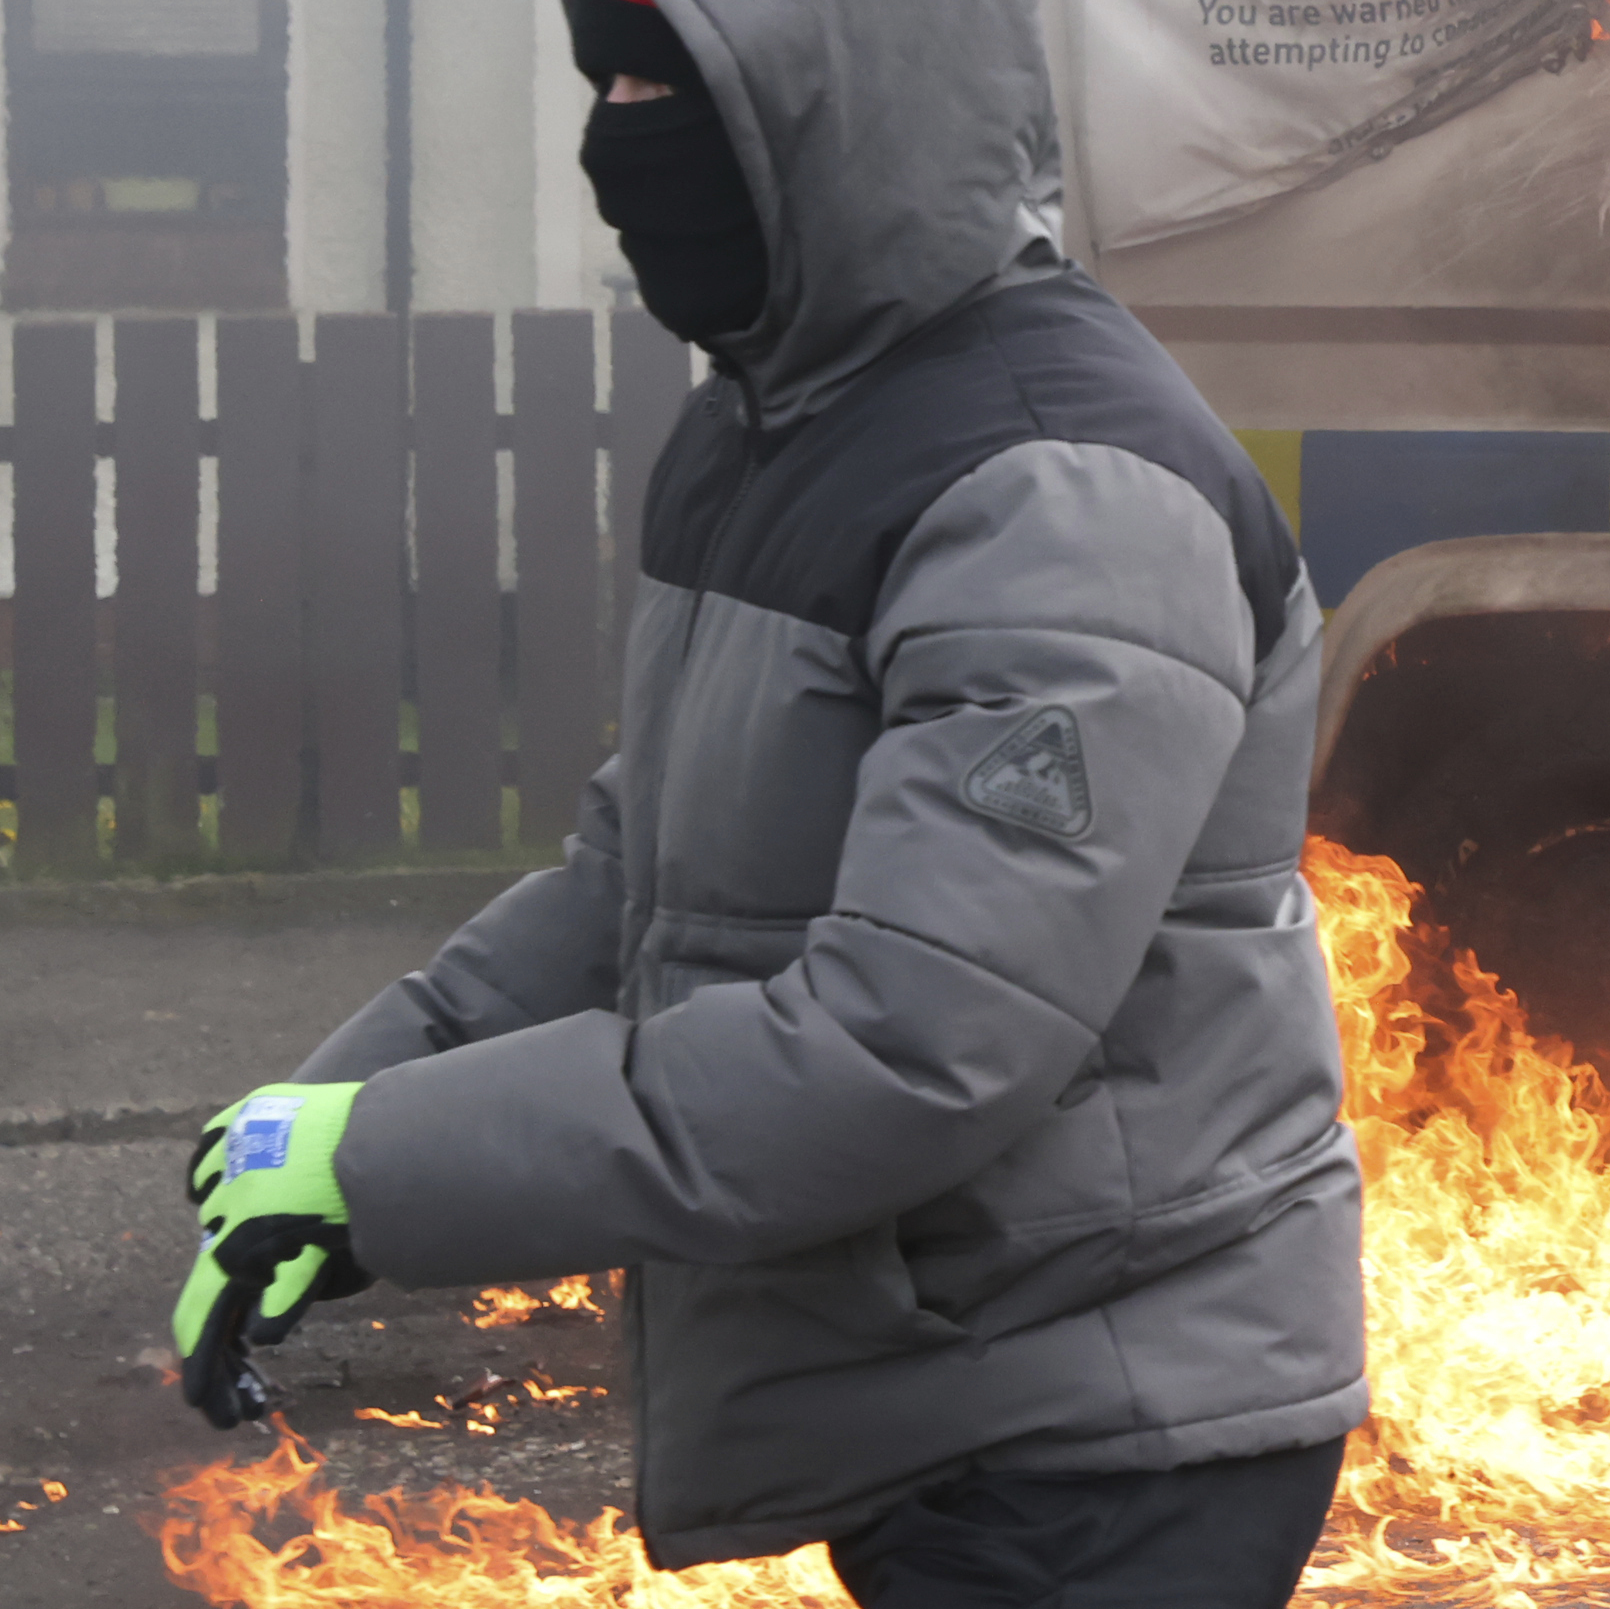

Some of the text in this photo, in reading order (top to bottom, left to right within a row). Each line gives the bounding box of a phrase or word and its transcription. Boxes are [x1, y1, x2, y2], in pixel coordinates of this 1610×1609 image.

[1268, 3, 1321, 26] are
[1209, 35, 1391, 71] attempting
[1400, 32, 1425, 56] to
